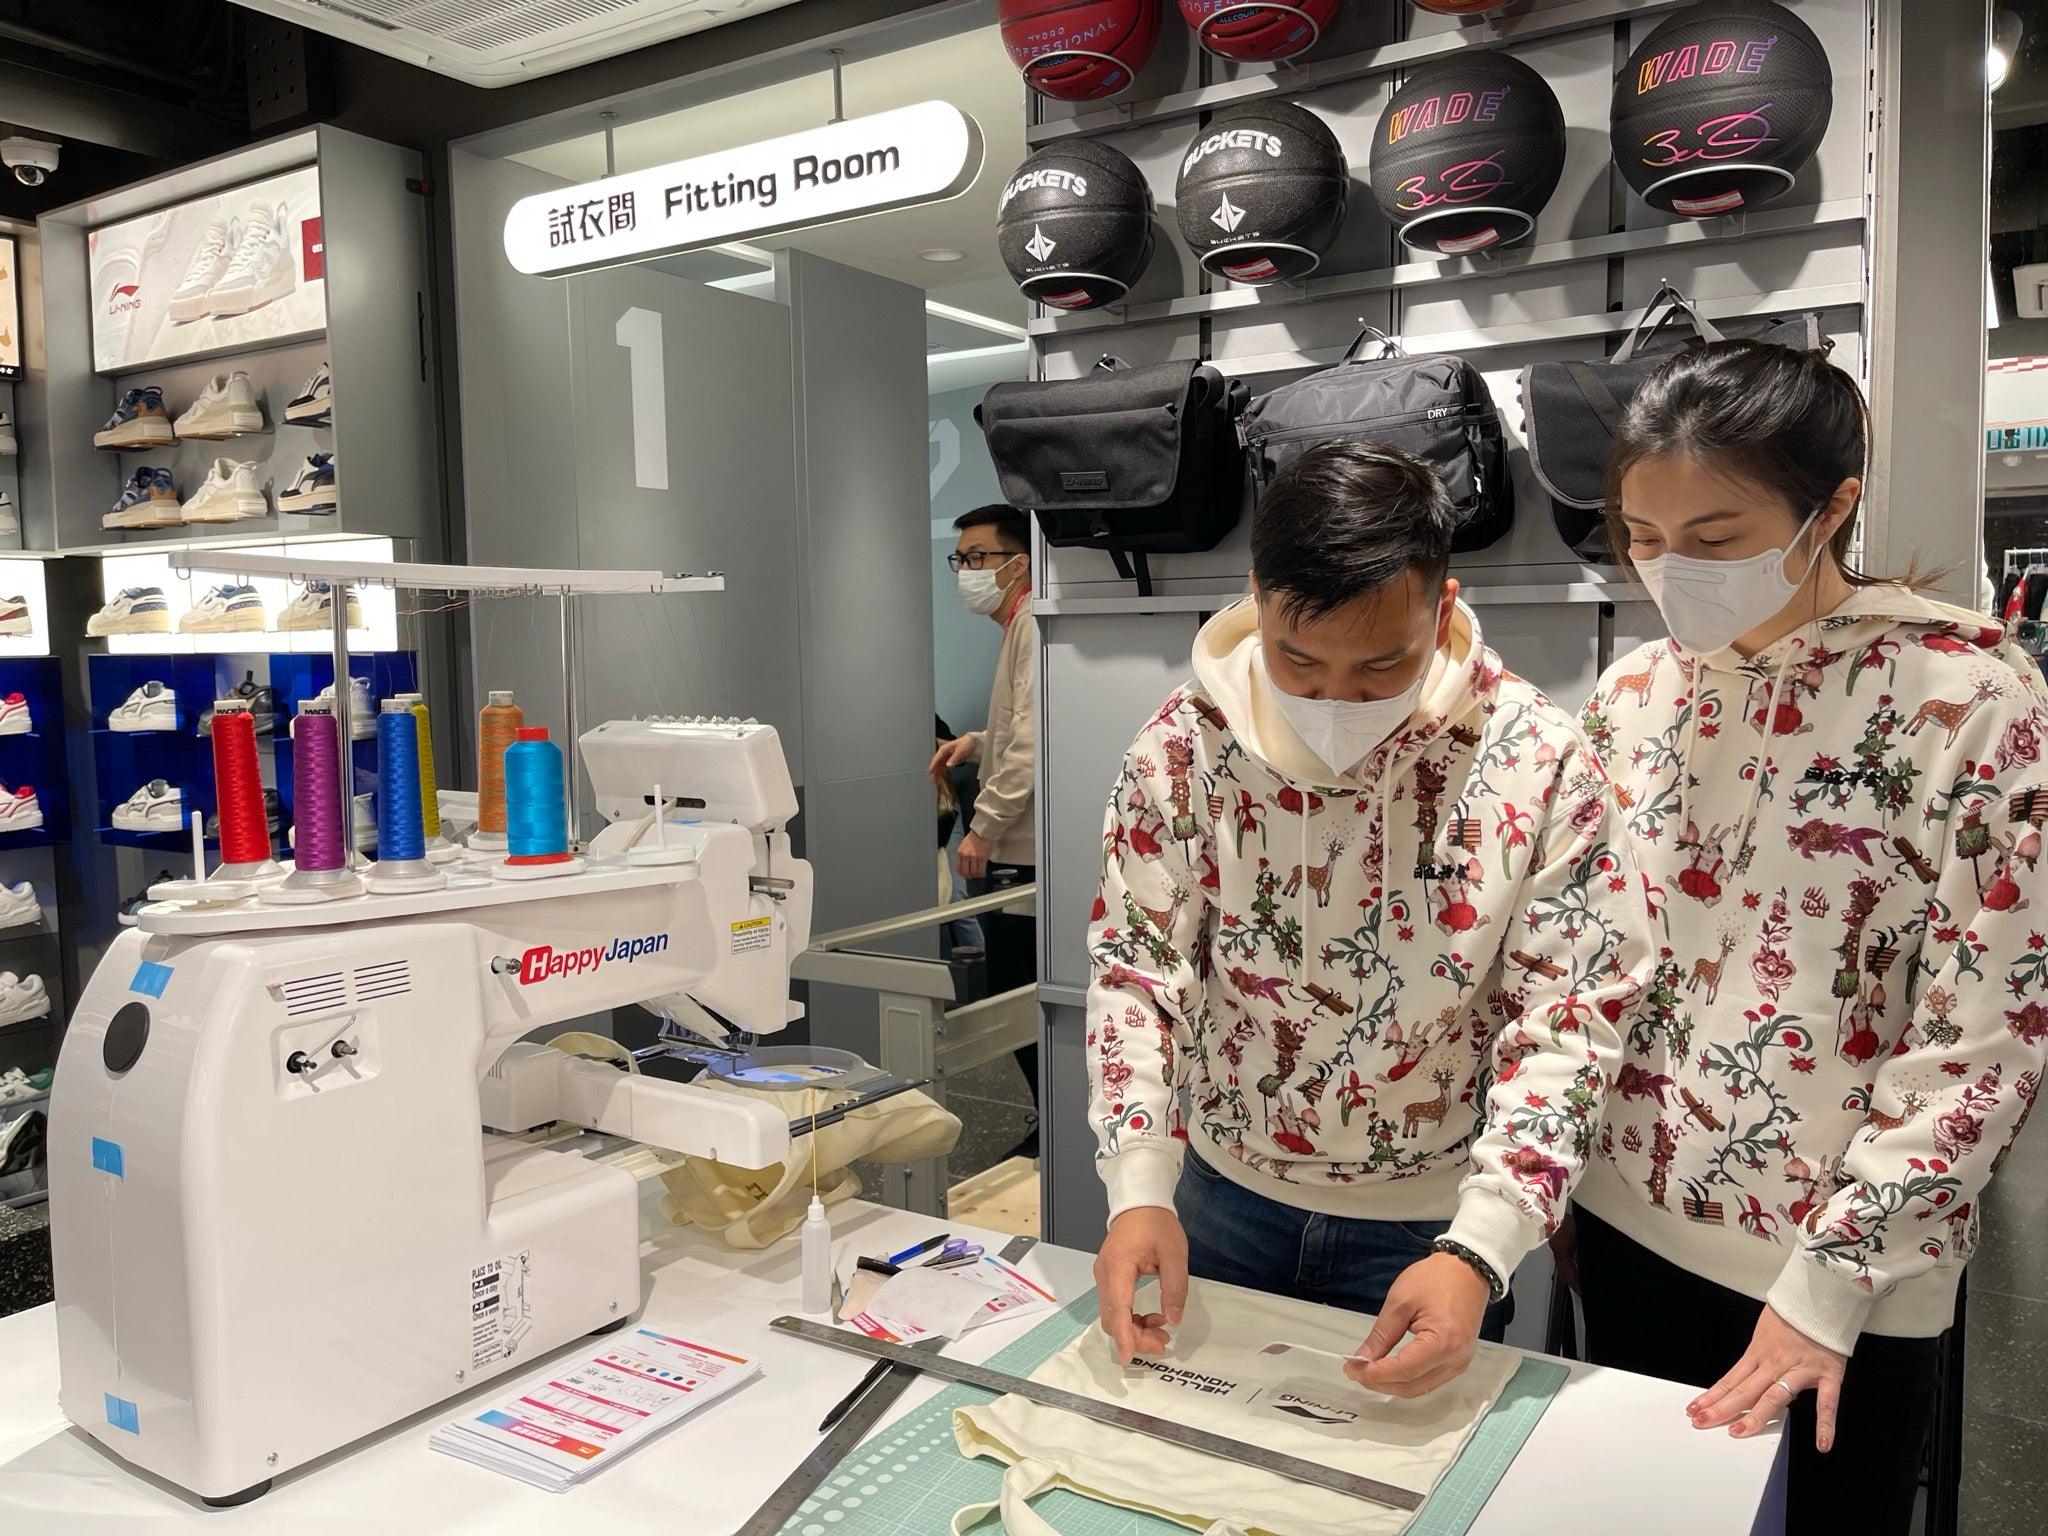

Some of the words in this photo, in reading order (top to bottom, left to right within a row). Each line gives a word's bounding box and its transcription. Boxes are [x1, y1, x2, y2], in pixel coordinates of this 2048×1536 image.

[1637, 40, 1766, 95] WADE
[1388, 90, 1503, 144] WADE
[1183, 129, 1282, 178] BUCKETS
[549, 190, 637, 248] 試衣間
[664, 171, 777, 219] Fitting
[794, 145, 900, 191] Room
[1001, 169, 1087, 210] BUCKETS
[109, 299, 141, 315] LI-NING
[615, 306, 669, 490] 1
[1427, 407, 1448, 419] DRY
[1159, 1373, 1235, 1396] HELLO
[1278, 1393, 1359, 1420] LI-NING
